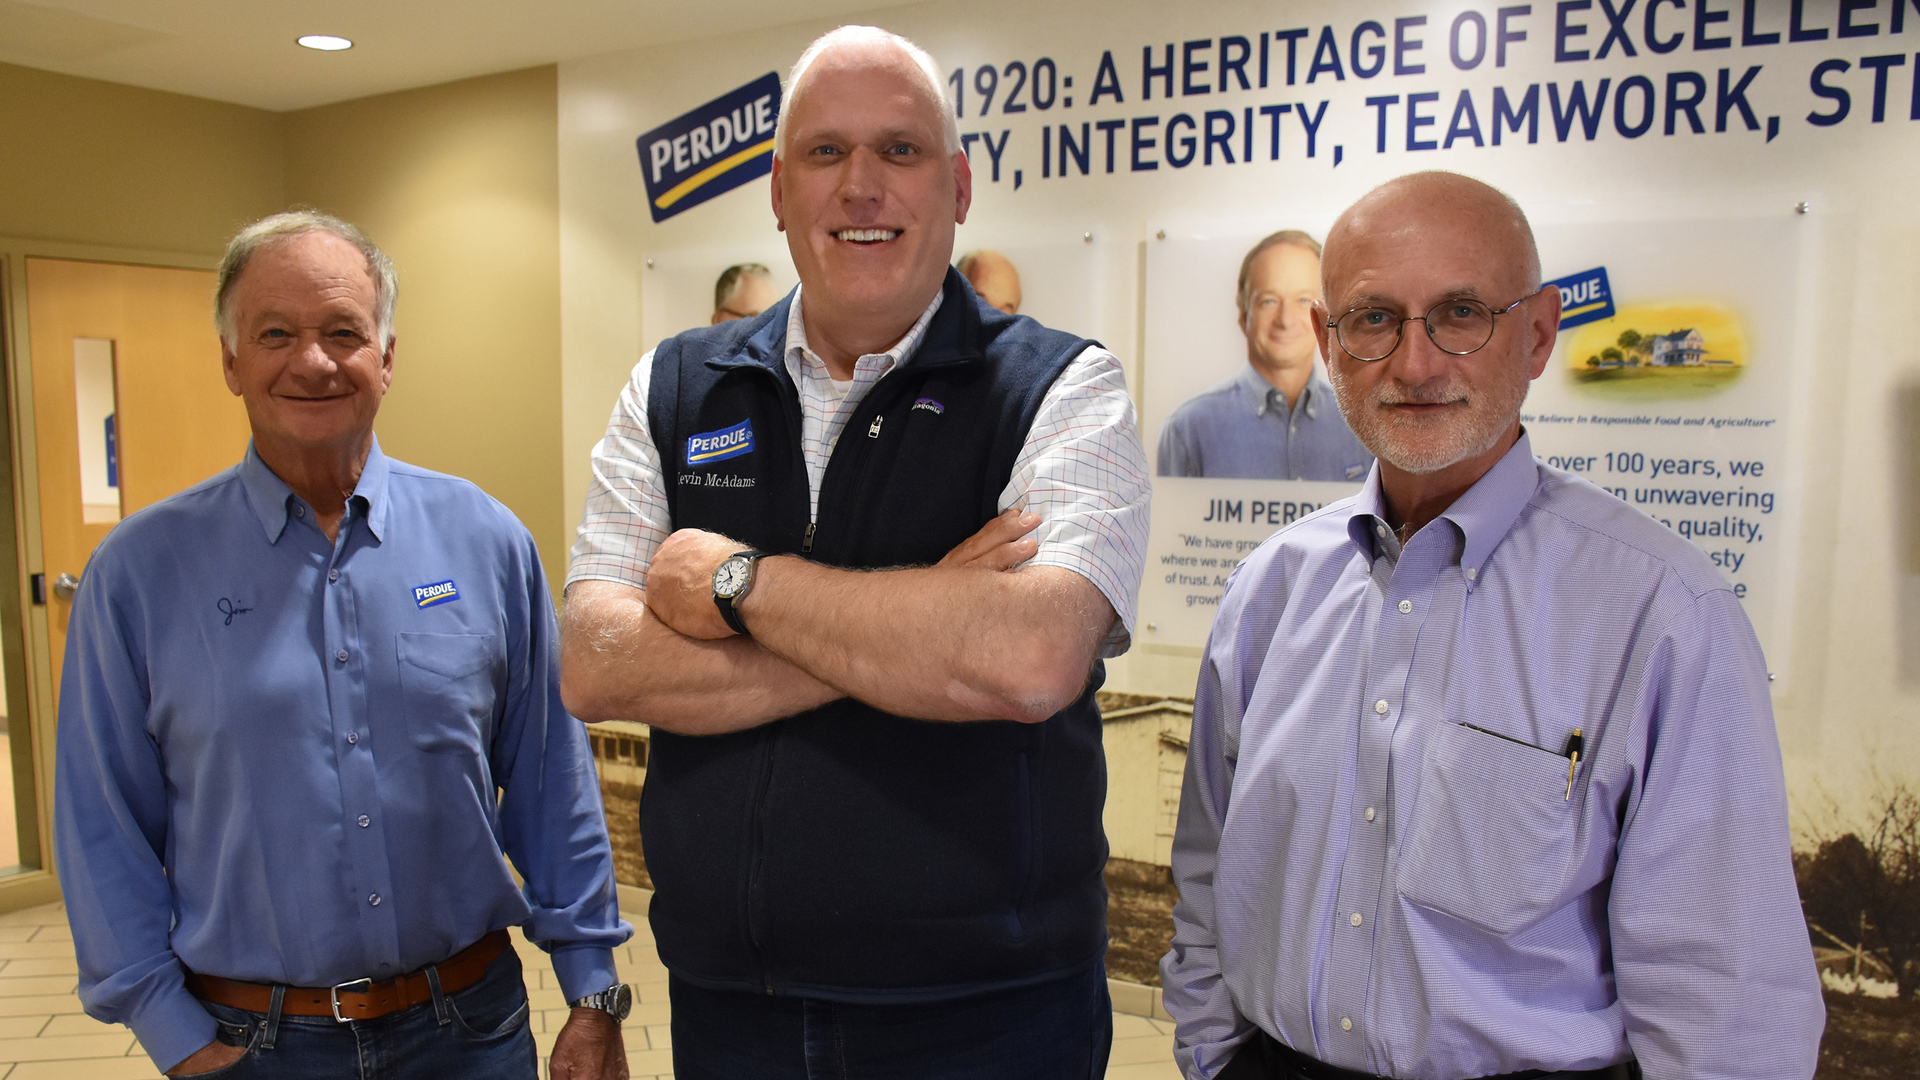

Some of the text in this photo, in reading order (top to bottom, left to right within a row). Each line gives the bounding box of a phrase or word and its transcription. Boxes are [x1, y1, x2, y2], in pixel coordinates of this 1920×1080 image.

[948, 57, 1073, 119] 1920:
[1089, 50, 1125, 105] A
[1142, 15, 1427, 100] HERITAGE
[1448, 5, 1532, 71] OF
[1042, 101, 1343, 178] INTEGRITY,
[1366, 65, 1780, 153] TEAMWORK,
[1806, 53, 1920, 127] ST
[650, 93, 774, 184] PERDUE
[1559, 278, 1601, 308] DUE
[1538, 414, 1574, 423] Believe
[1590, 415, 1651, 426] Responsible
[1654, 416, 1681, 425] Food
[1683, 416, 1705, 426] and
[691, 428, 747, 453] PERDUE
[1548, 452, 1764, 479] over 100 years, we
[704, 473, 756, 487] McAdams
[1204, 499, 1242, 523] JIM
[1635, 486, 1775, 514] unwavering
[1678, 516, 1763, 542] quality,
[1205, 536, 1233, 549] have
[1161, 554, 1198, 567] where
[1200, 558, 1217, 568] we
[415, 582, 453, 600] PERDUE
[1165, 573, 1177, 584] of
[1179, 574, 1210, 586] trust.
